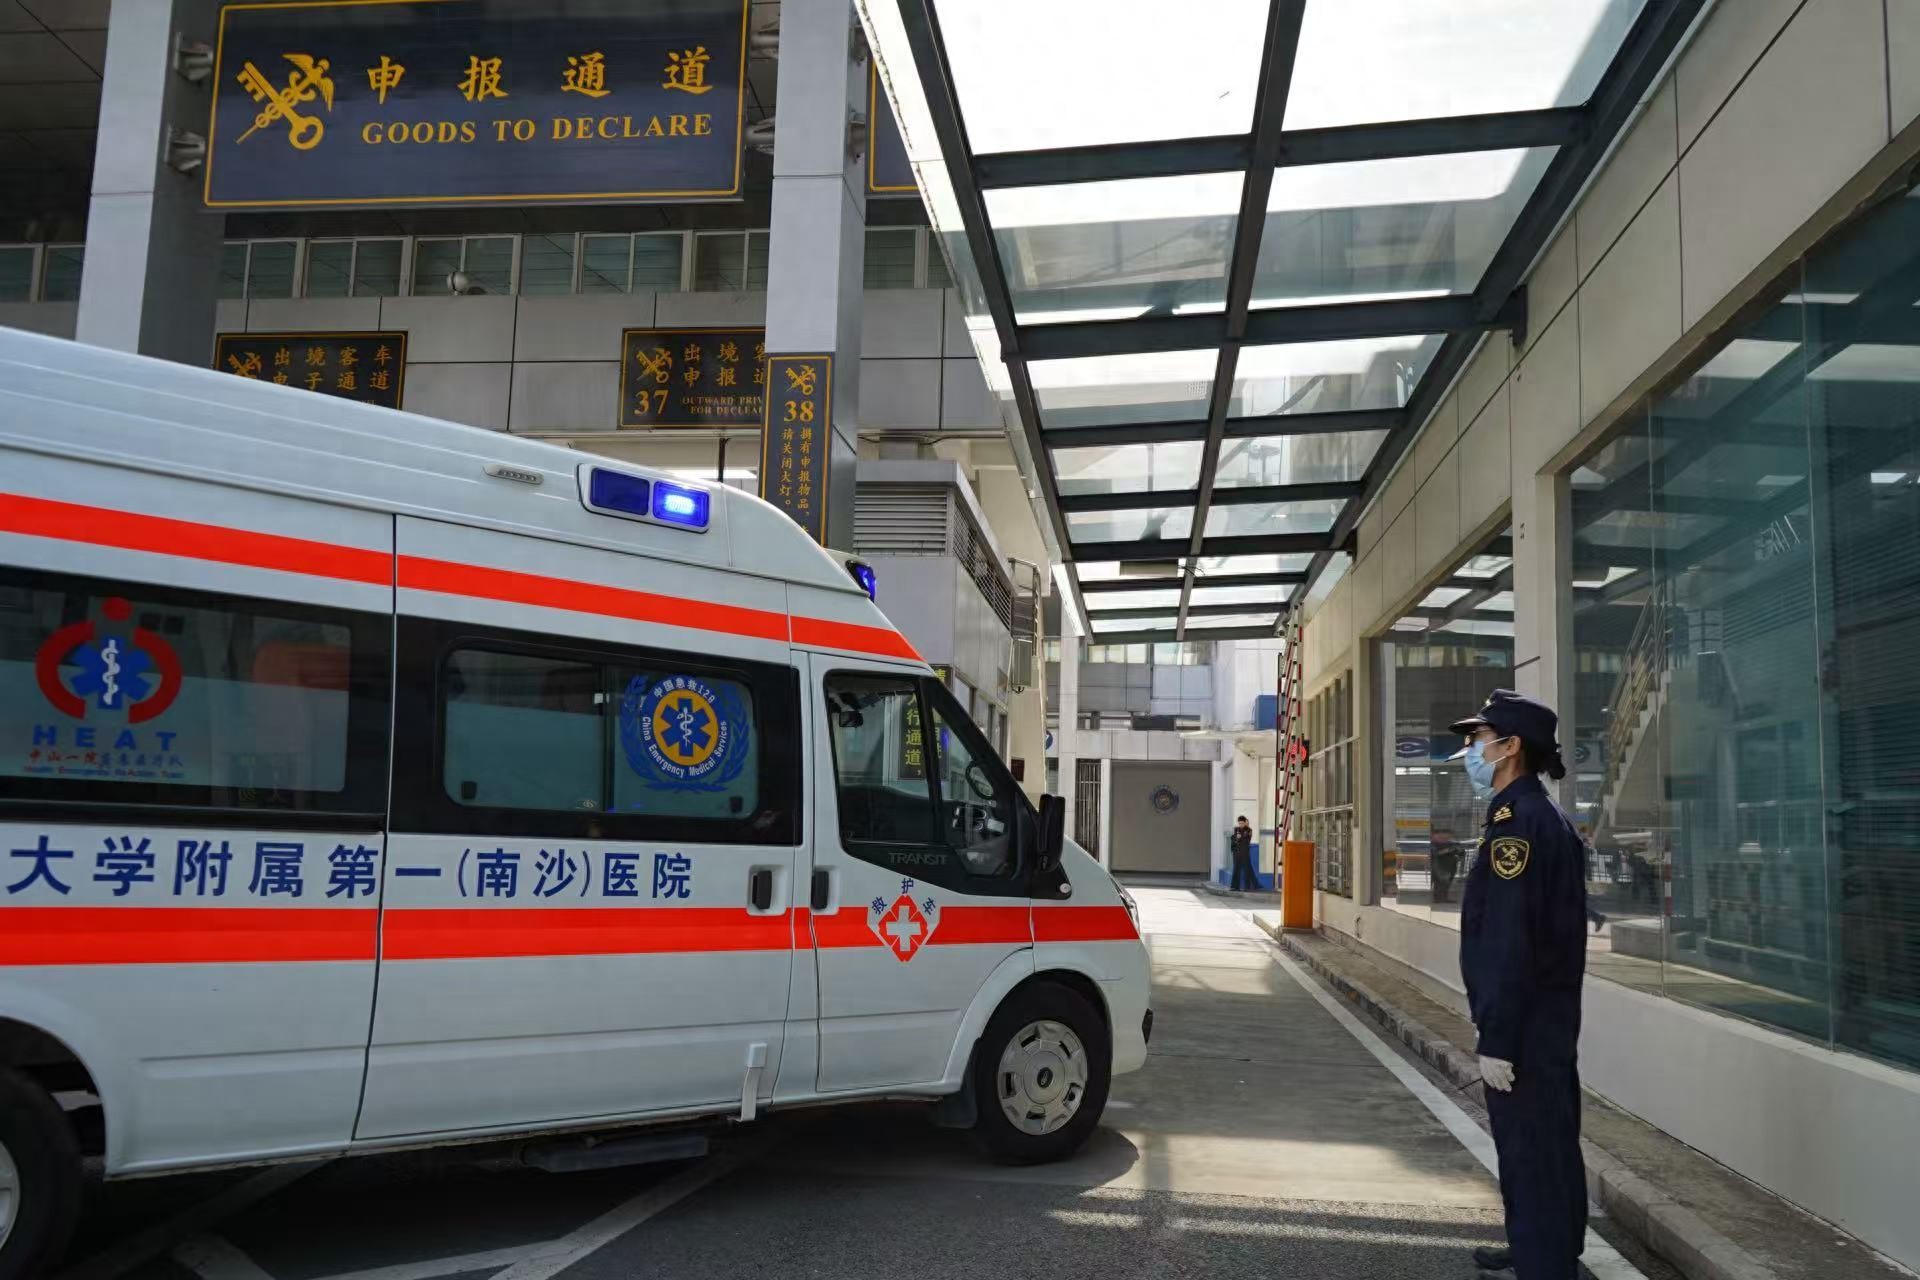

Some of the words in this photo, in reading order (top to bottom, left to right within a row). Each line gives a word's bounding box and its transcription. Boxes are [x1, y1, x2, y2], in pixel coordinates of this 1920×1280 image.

[366, 45, 714, 105] 申报通道
[361, 120, 477, 145] GOODS
[492, 117, 537, 142] TO
[551, 113, 713, 140] DECLARE
[273, 344, 393, 367] 出境客车
[634, 389, 669, 415] 37
[682, 396, 734, 406] OUTWARD
[690, 405, 712, 415] FOR
[783, 400, 814, 422] 38
[32, 724, 177, 751] HEAT
[641, 715, 652, 741] China
[648, 743, 685, 778] Emergency
[688, 757, 716, 777] Medical
[713, 720, 728, 758] Services
[888, 852, 949, 866] TRANSIT
[871, 877, 936, 916] 救护车
